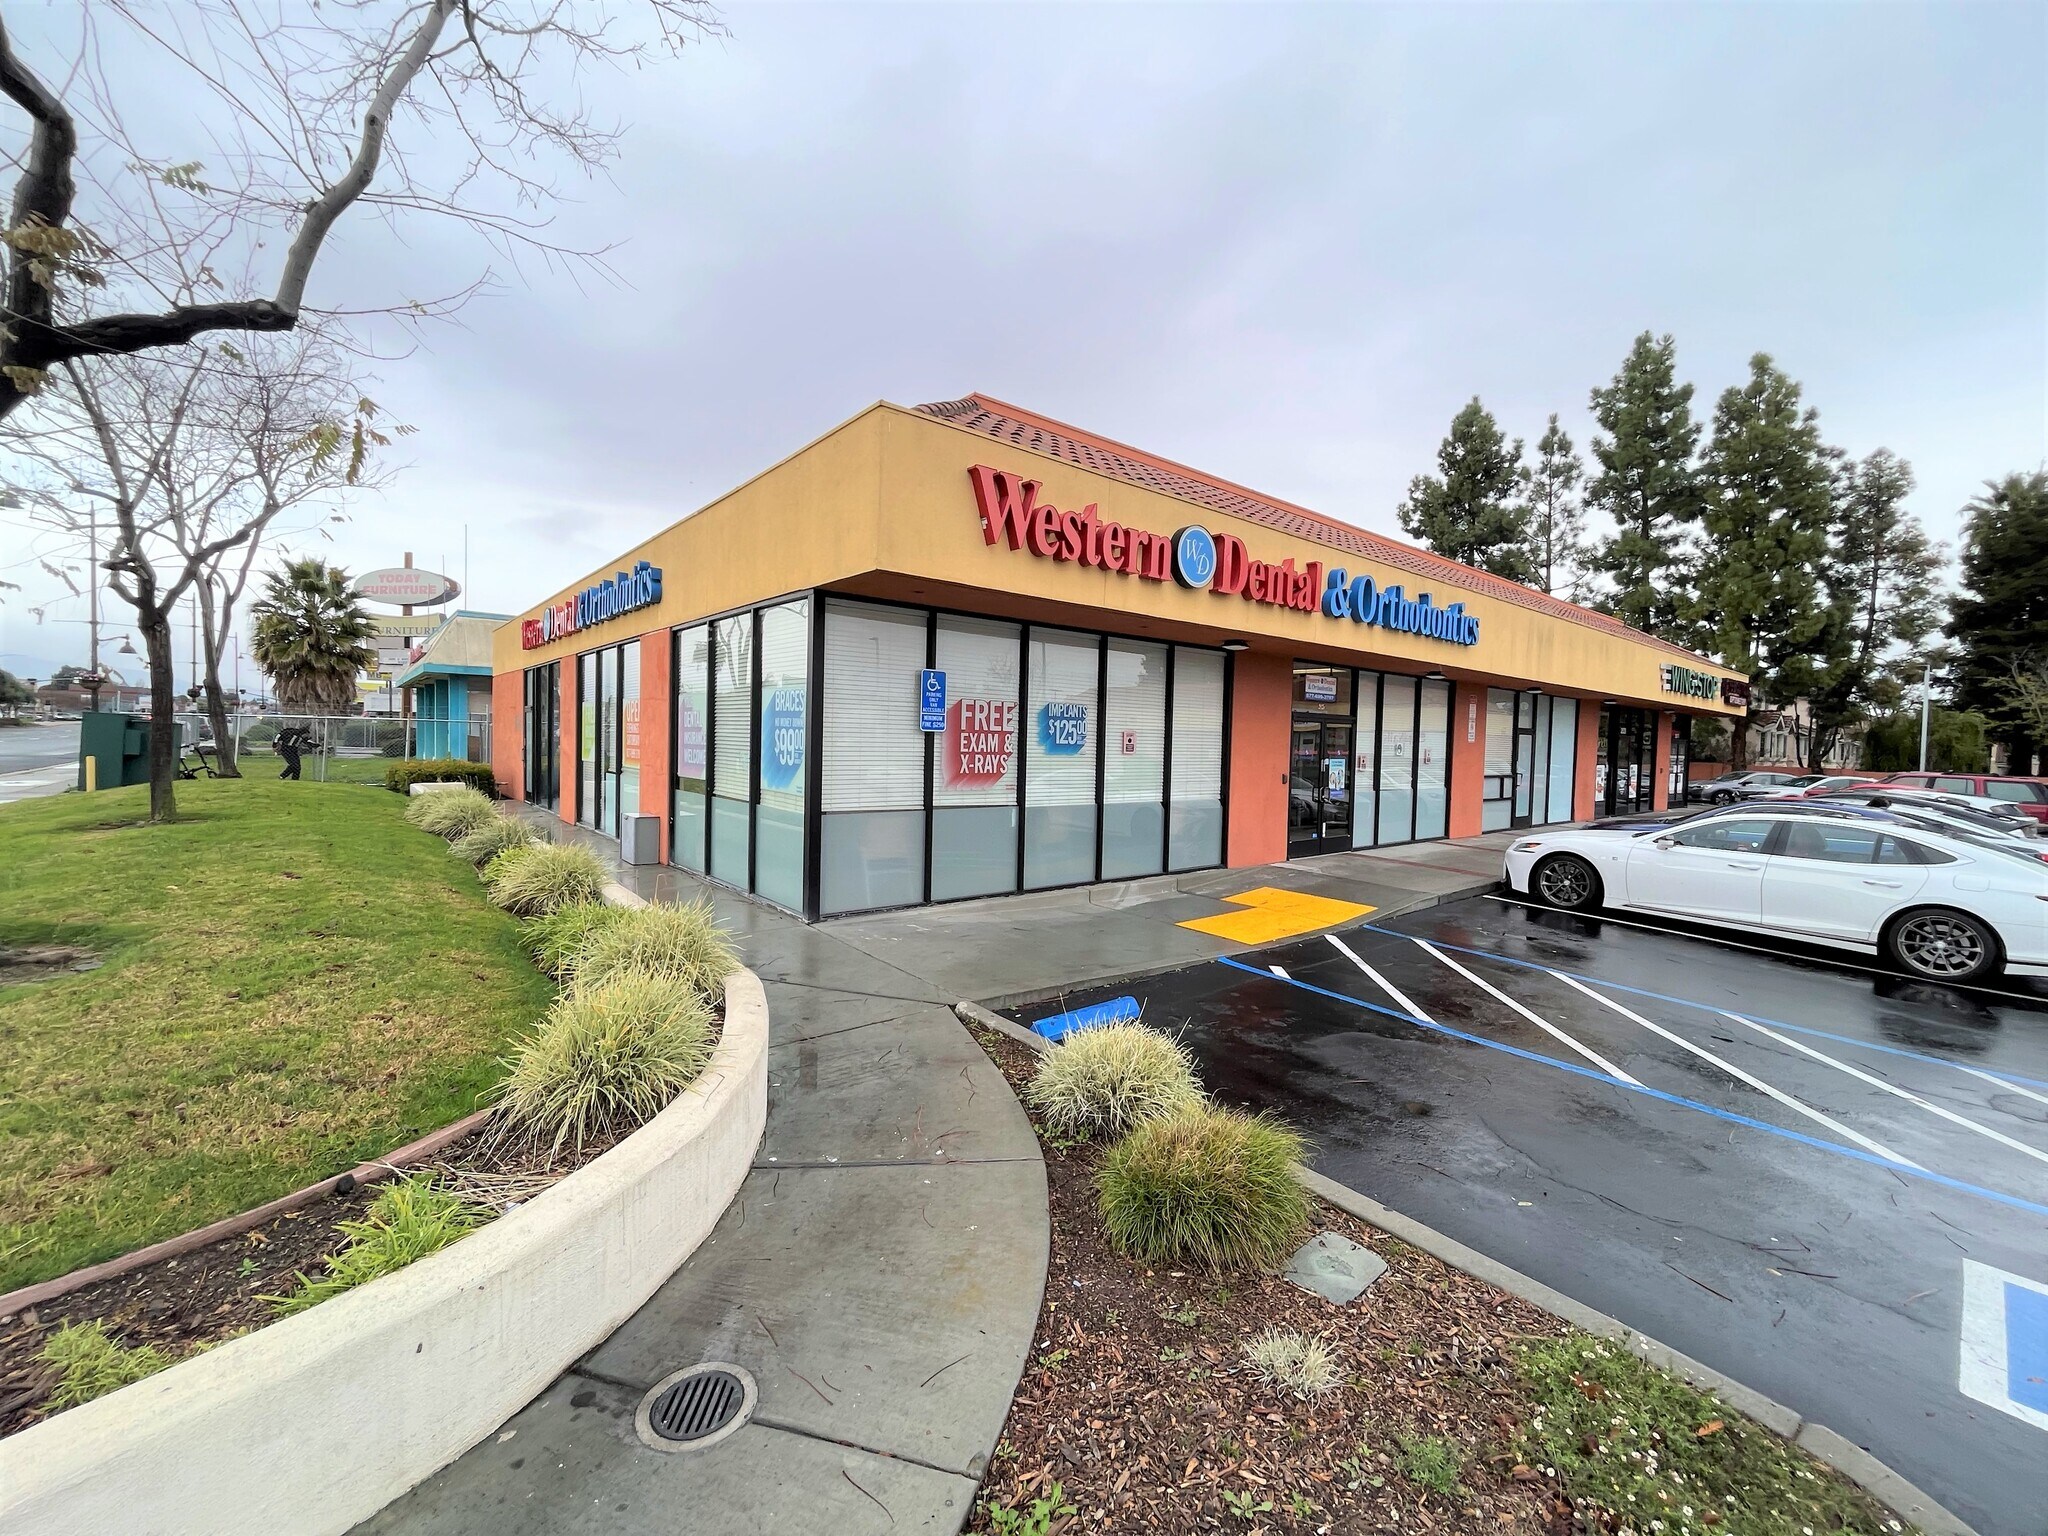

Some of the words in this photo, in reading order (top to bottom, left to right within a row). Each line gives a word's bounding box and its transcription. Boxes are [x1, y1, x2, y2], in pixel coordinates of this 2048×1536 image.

[968, 464, 1173, 582] Western
[1209, 533, 1323, 612] Dental
[1322, 568, 1352, 618] &
[1350, 575, 1481, 646] Orthodontics
[378, 573, 421, 583] TODAY
[362, 585, 437, 595] FURNITURE
[550, 595, 579, 640] Dental
[585, 560, 662, 626] Orthodontics
[775, 690, 804, 711] BRACES
[1049, 703, 1088, 718] IMPLANTS
[683, 711, 703, 728] DENTAL
[960, 700, 1014, 731] FREE
[960, 733, 998, 752] EXAM
[1004, 733, 1013, 753] &
[960, 754, 1008, 774] X-RAYS
